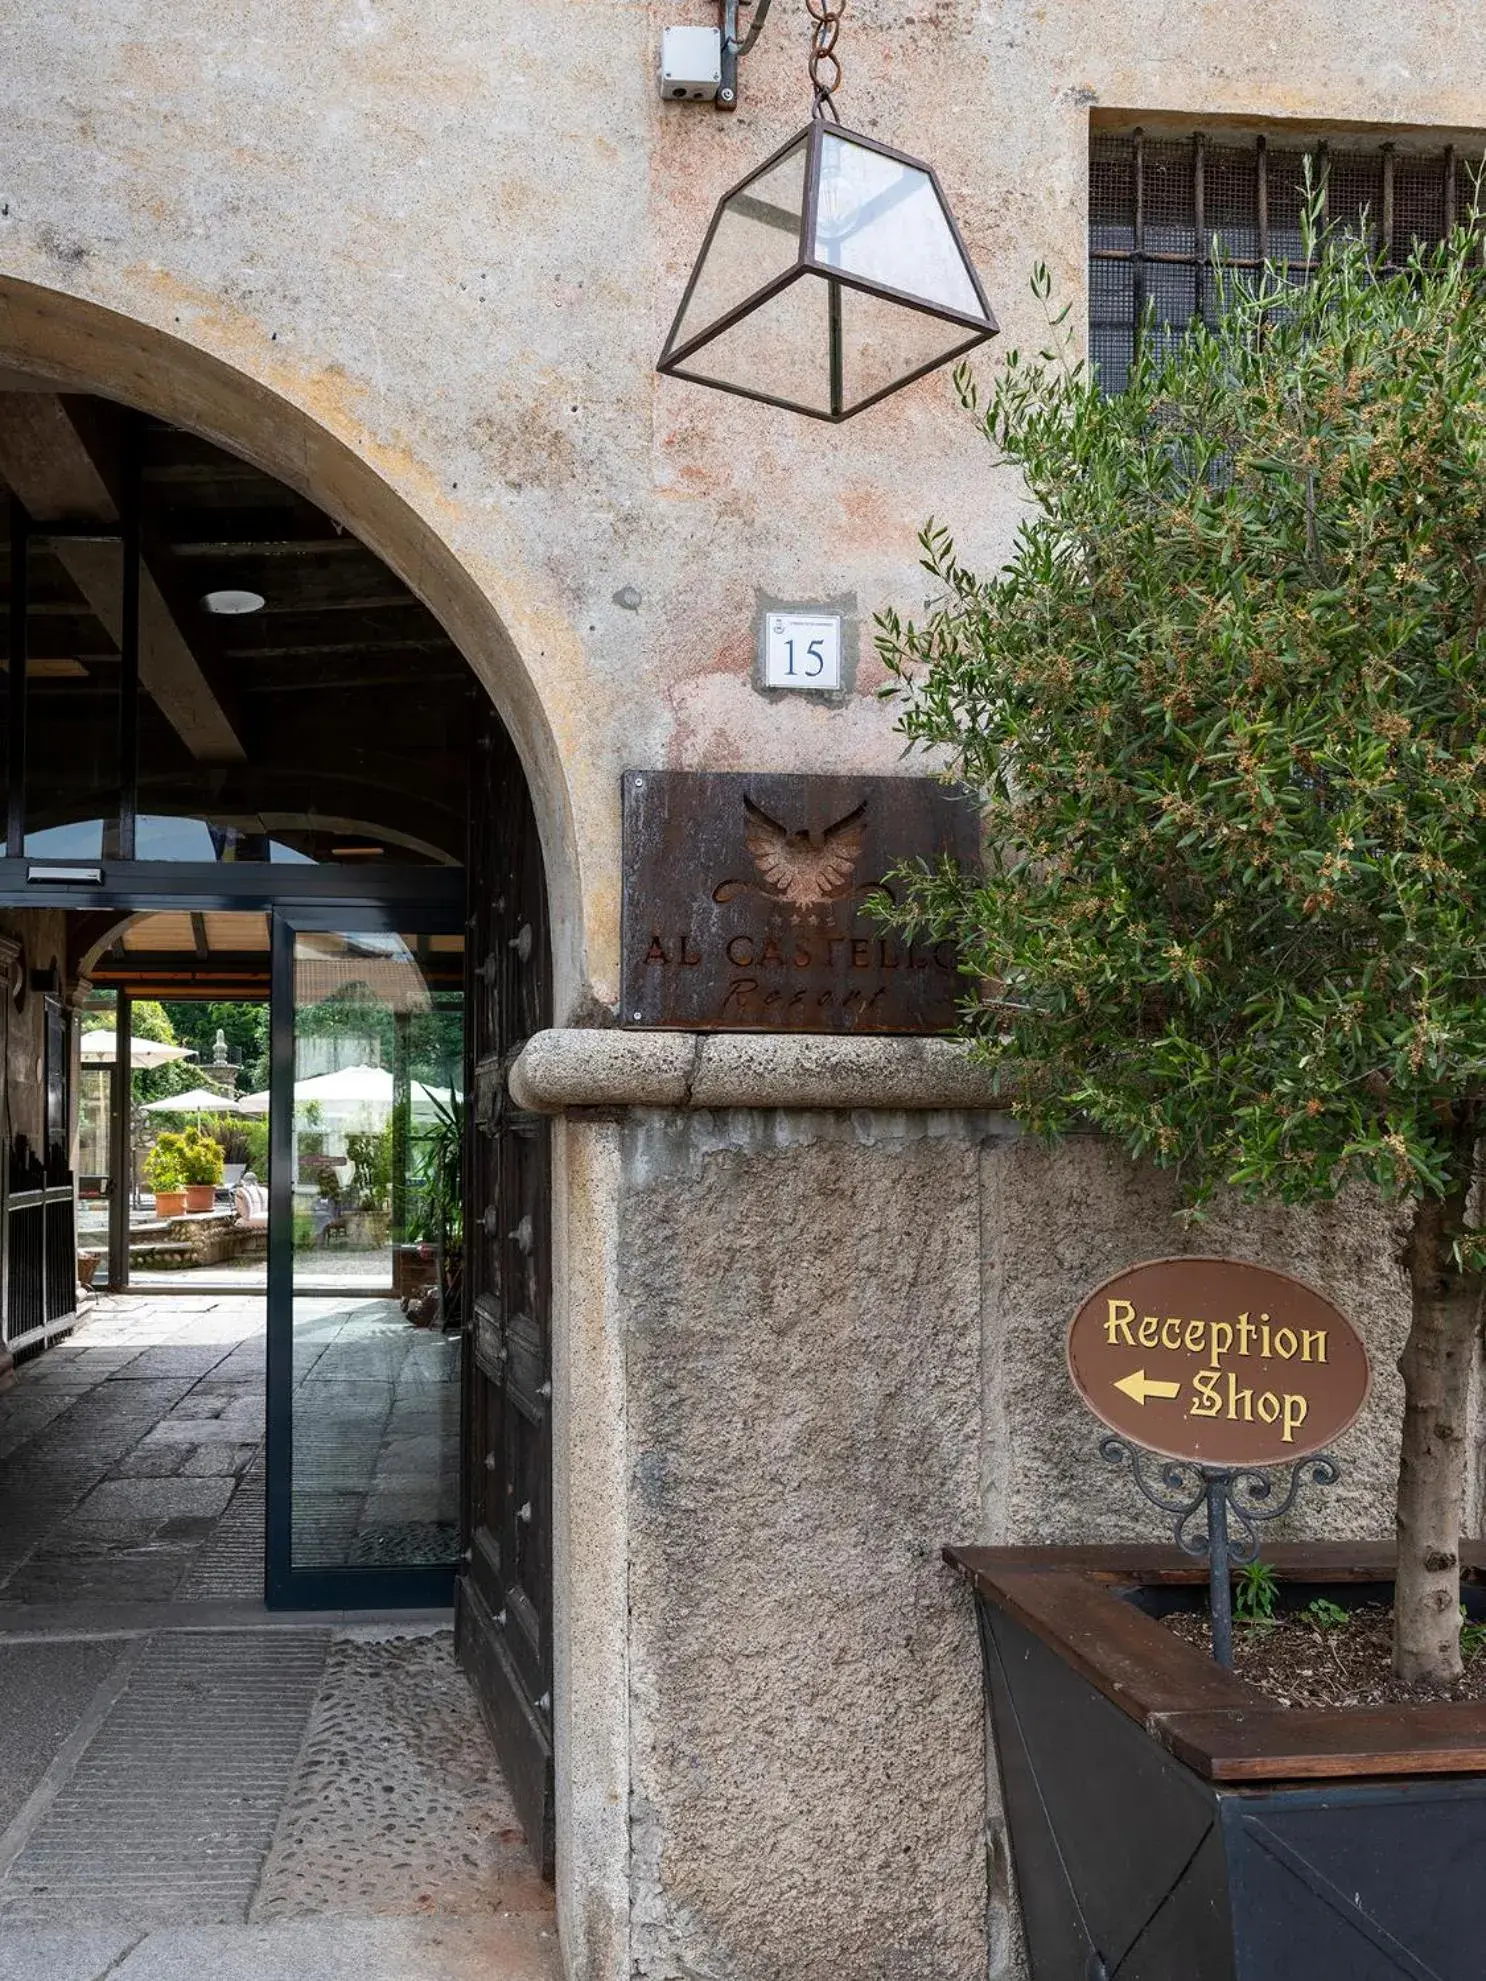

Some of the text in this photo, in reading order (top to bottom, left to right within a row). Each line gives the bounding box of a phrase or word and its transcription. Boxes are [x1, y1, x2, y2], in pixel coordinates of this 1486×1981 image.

[784, 639, 824, 677] 15
[645, 935, 701, 967] AL
[1104, 1299, 1328, 1367] Reception
[1190, 1370, 1309, 1442] Shop
